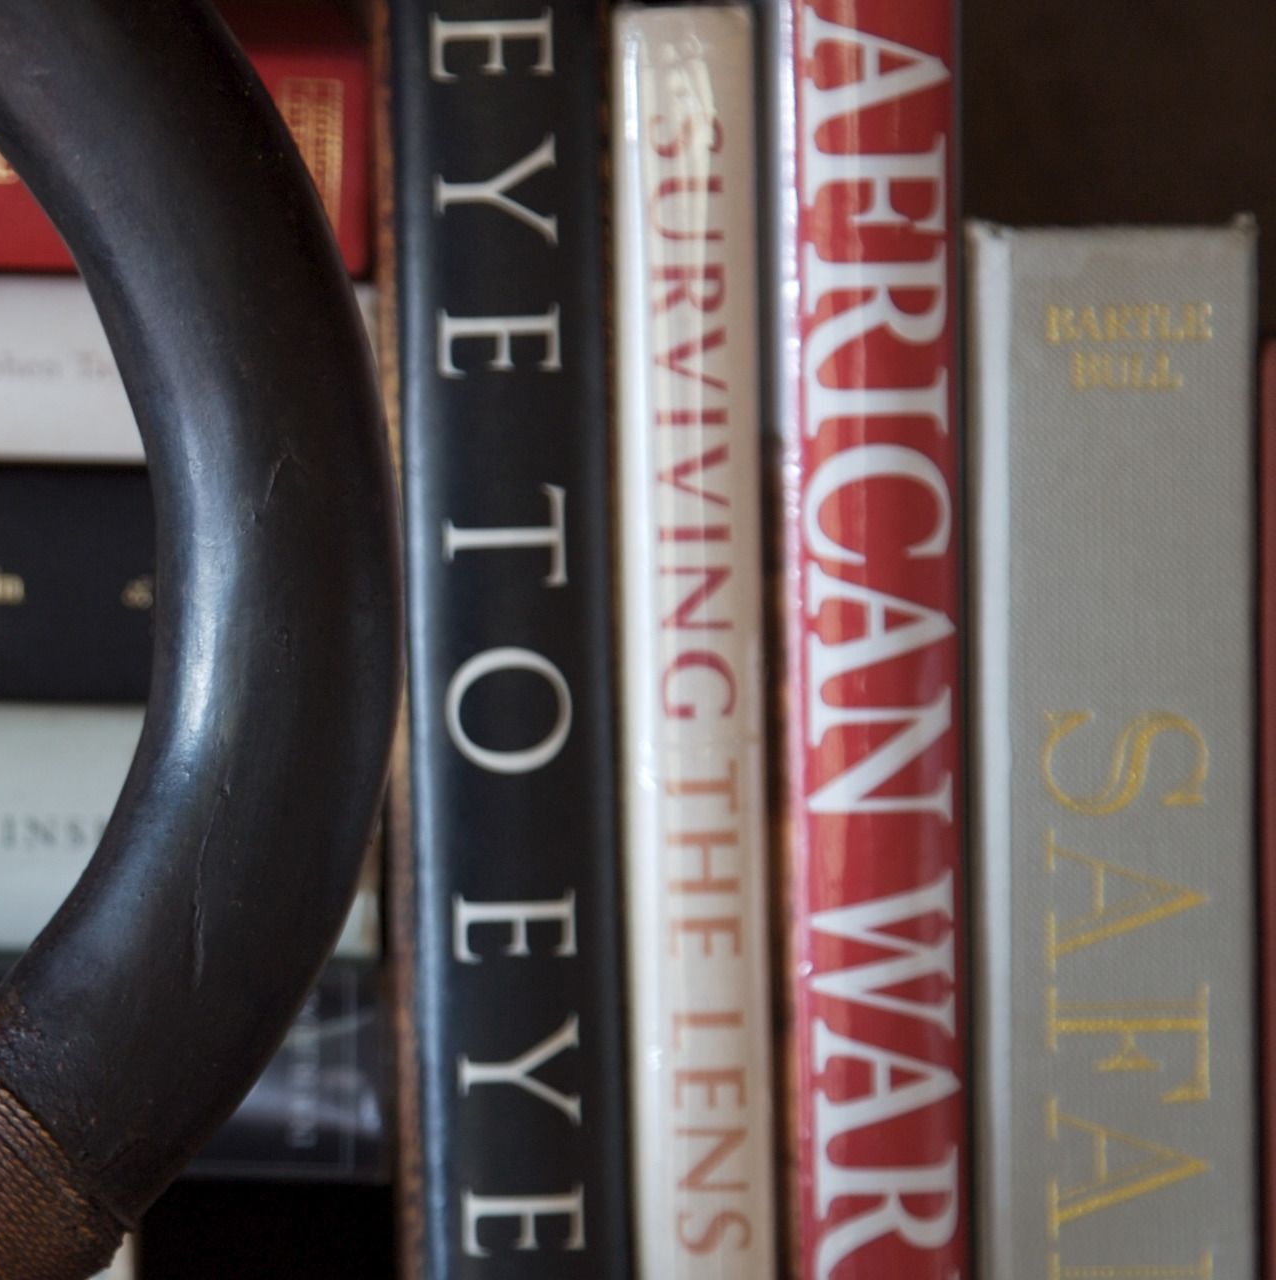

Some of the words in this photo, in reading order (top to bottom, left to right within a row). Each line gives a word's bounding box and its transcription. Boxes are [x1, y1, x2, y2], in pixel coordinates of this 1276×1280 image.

[429, 13, 562, 380] EYE
[645, 113, 736, 721] SURVIVING
[802, 6, 958, 826] AFRICAN
[441, 482, 573, 774] TO
[664, 759, 744, 959] THE
[452, 889, 586, 1259] EYE
[671, 1010, 754, 1256] LENS
